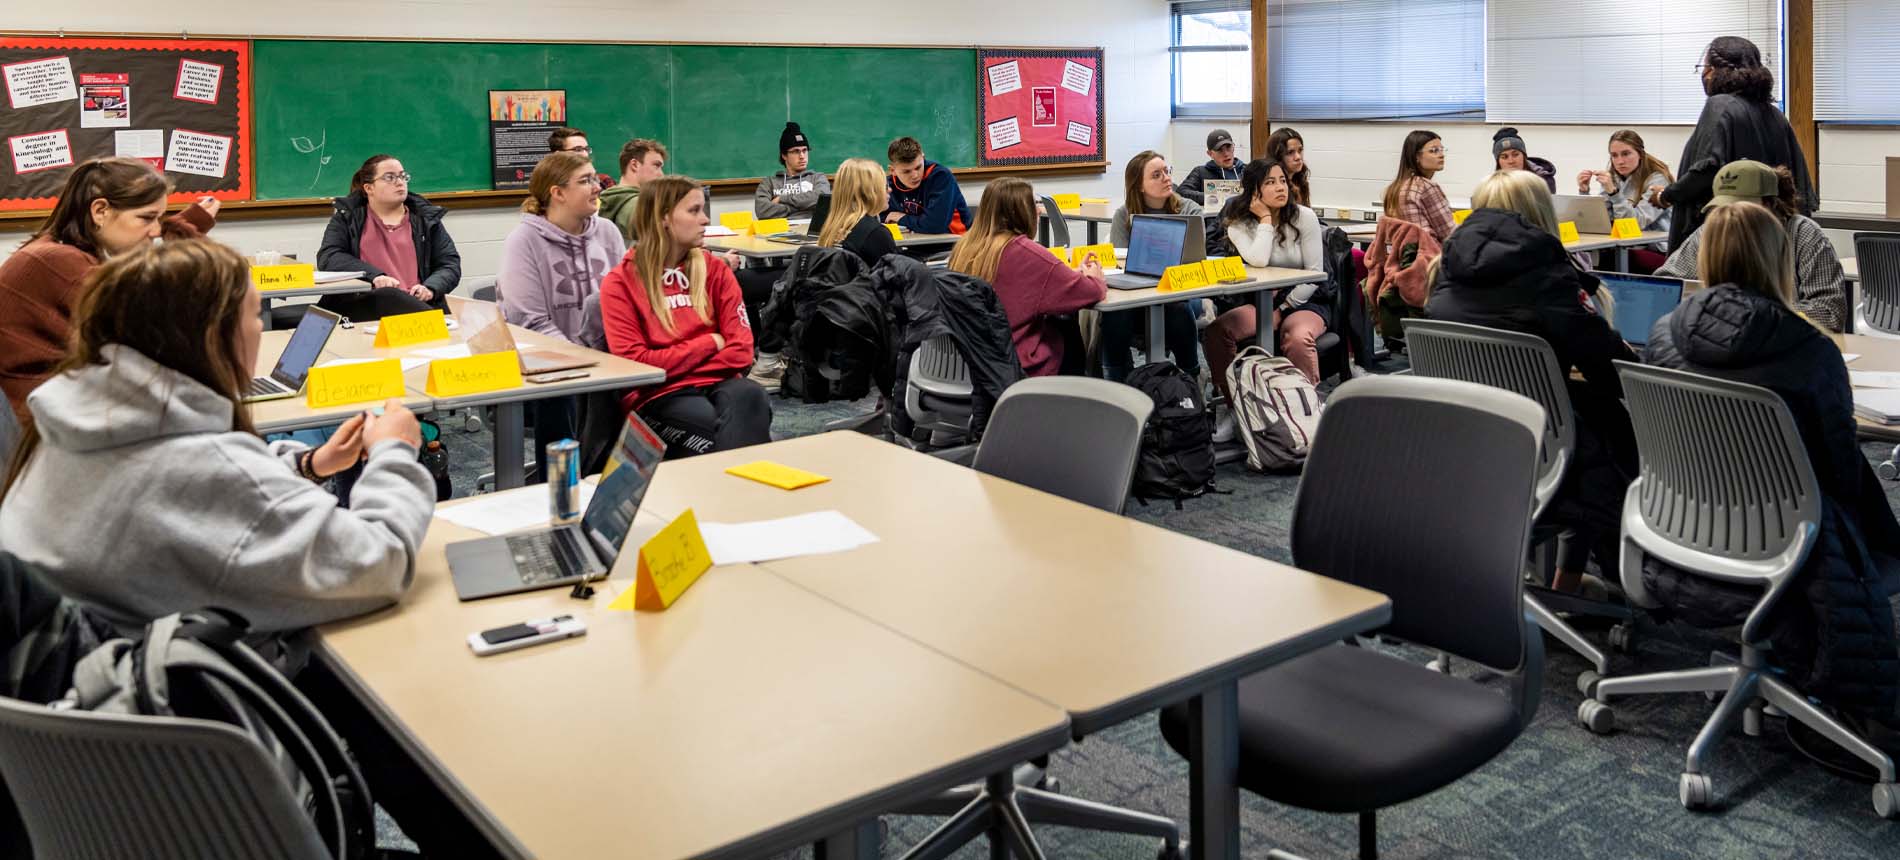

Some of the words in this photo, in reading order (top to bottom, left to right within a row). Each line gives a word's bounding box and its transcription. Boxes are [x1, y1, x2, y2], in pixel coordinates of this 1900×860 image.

[16, 147, 52, 157] Kinesiology
[24, 158, 64, 168] Management
[682, 434, 714, 454] NIKE
